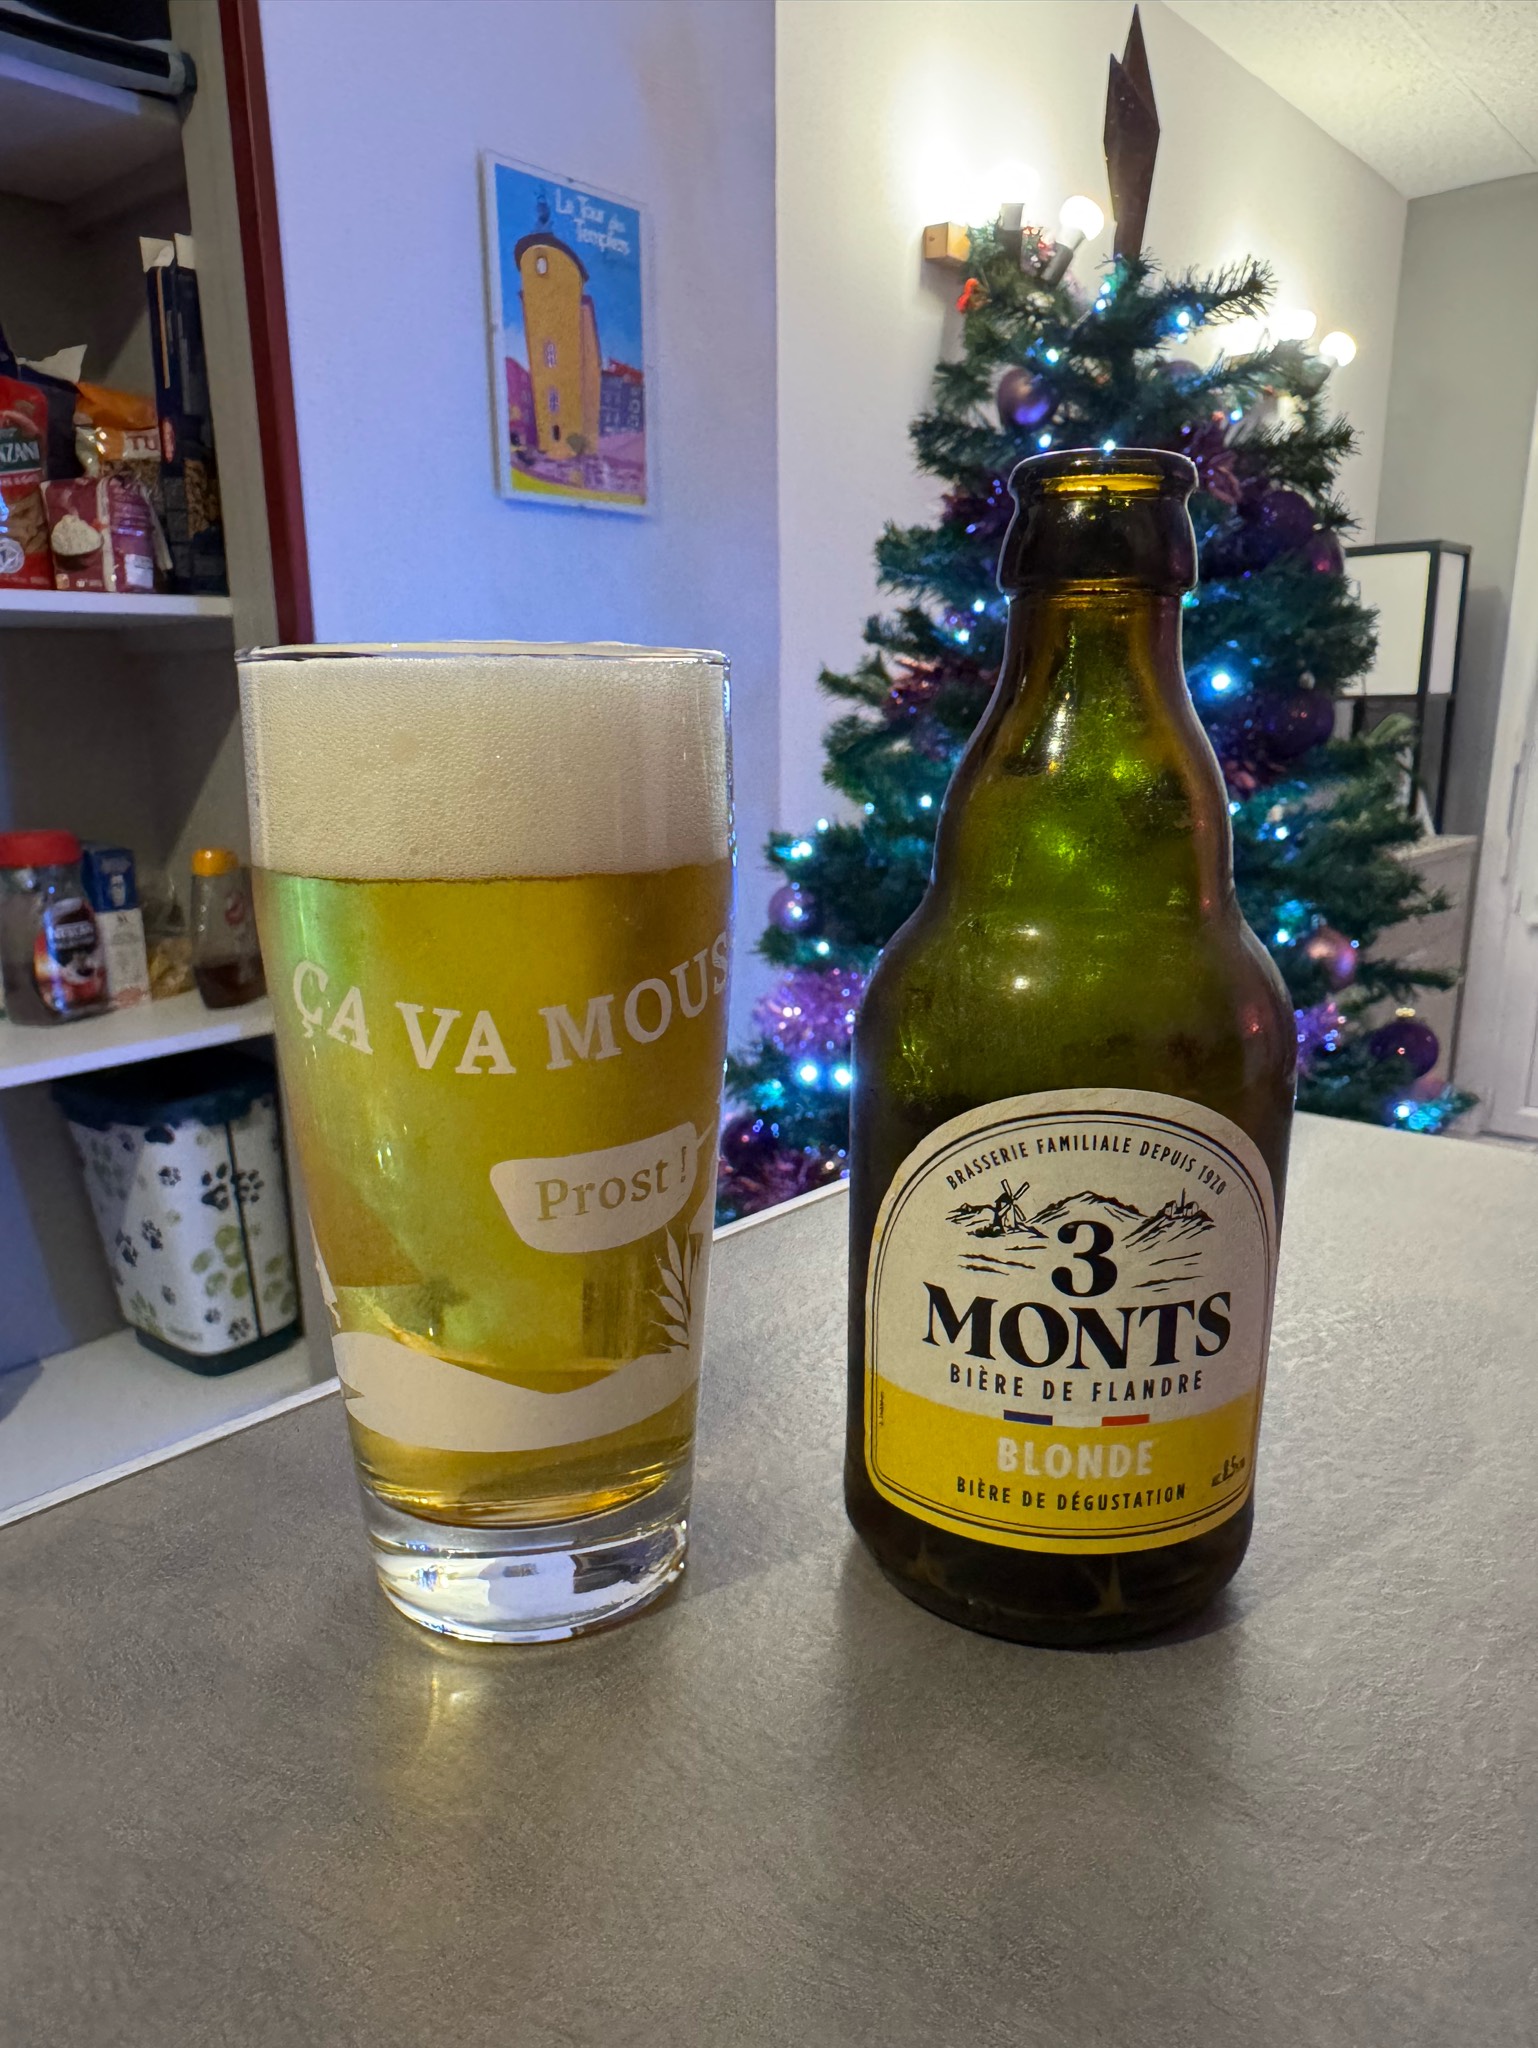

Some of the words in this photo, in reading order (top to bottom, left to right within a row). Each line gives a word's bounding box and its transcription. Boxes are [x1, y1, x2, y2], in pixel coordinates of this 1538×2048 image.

[292, 960, 374, 1055] ÇA
[395, 1001, 517, 1075] VA
[538, 931, 729, 1071] MOUS
[535, 1159, 670, 1221] Prost
[945, 1141, 1029, 1191] BRASSERIE
[1036, 1134, 1132, 1155] FAMILIALE
[1138, 1140, 1197, 1173] DEPUIS
[1197, 1164, 1228, 1196] 1920
[1051, 1219, 1118, 1298] 3
[922, 1281, 1232, 1370] MONTS
[950, 1363, 1024, 1398] BIÈRE
[1042, 1379, 1073, 1402] DE
[1092, 1369, 1203, 1402] FLANDRE
[996, 1436, 1154, 1480] BLONDE
[956, 1475, 1011, 1504] BIÈRE
[1022, 1490, 1046, 1509] DE
[1057, 1483, 1186, 1512] DÉGUSTATION
